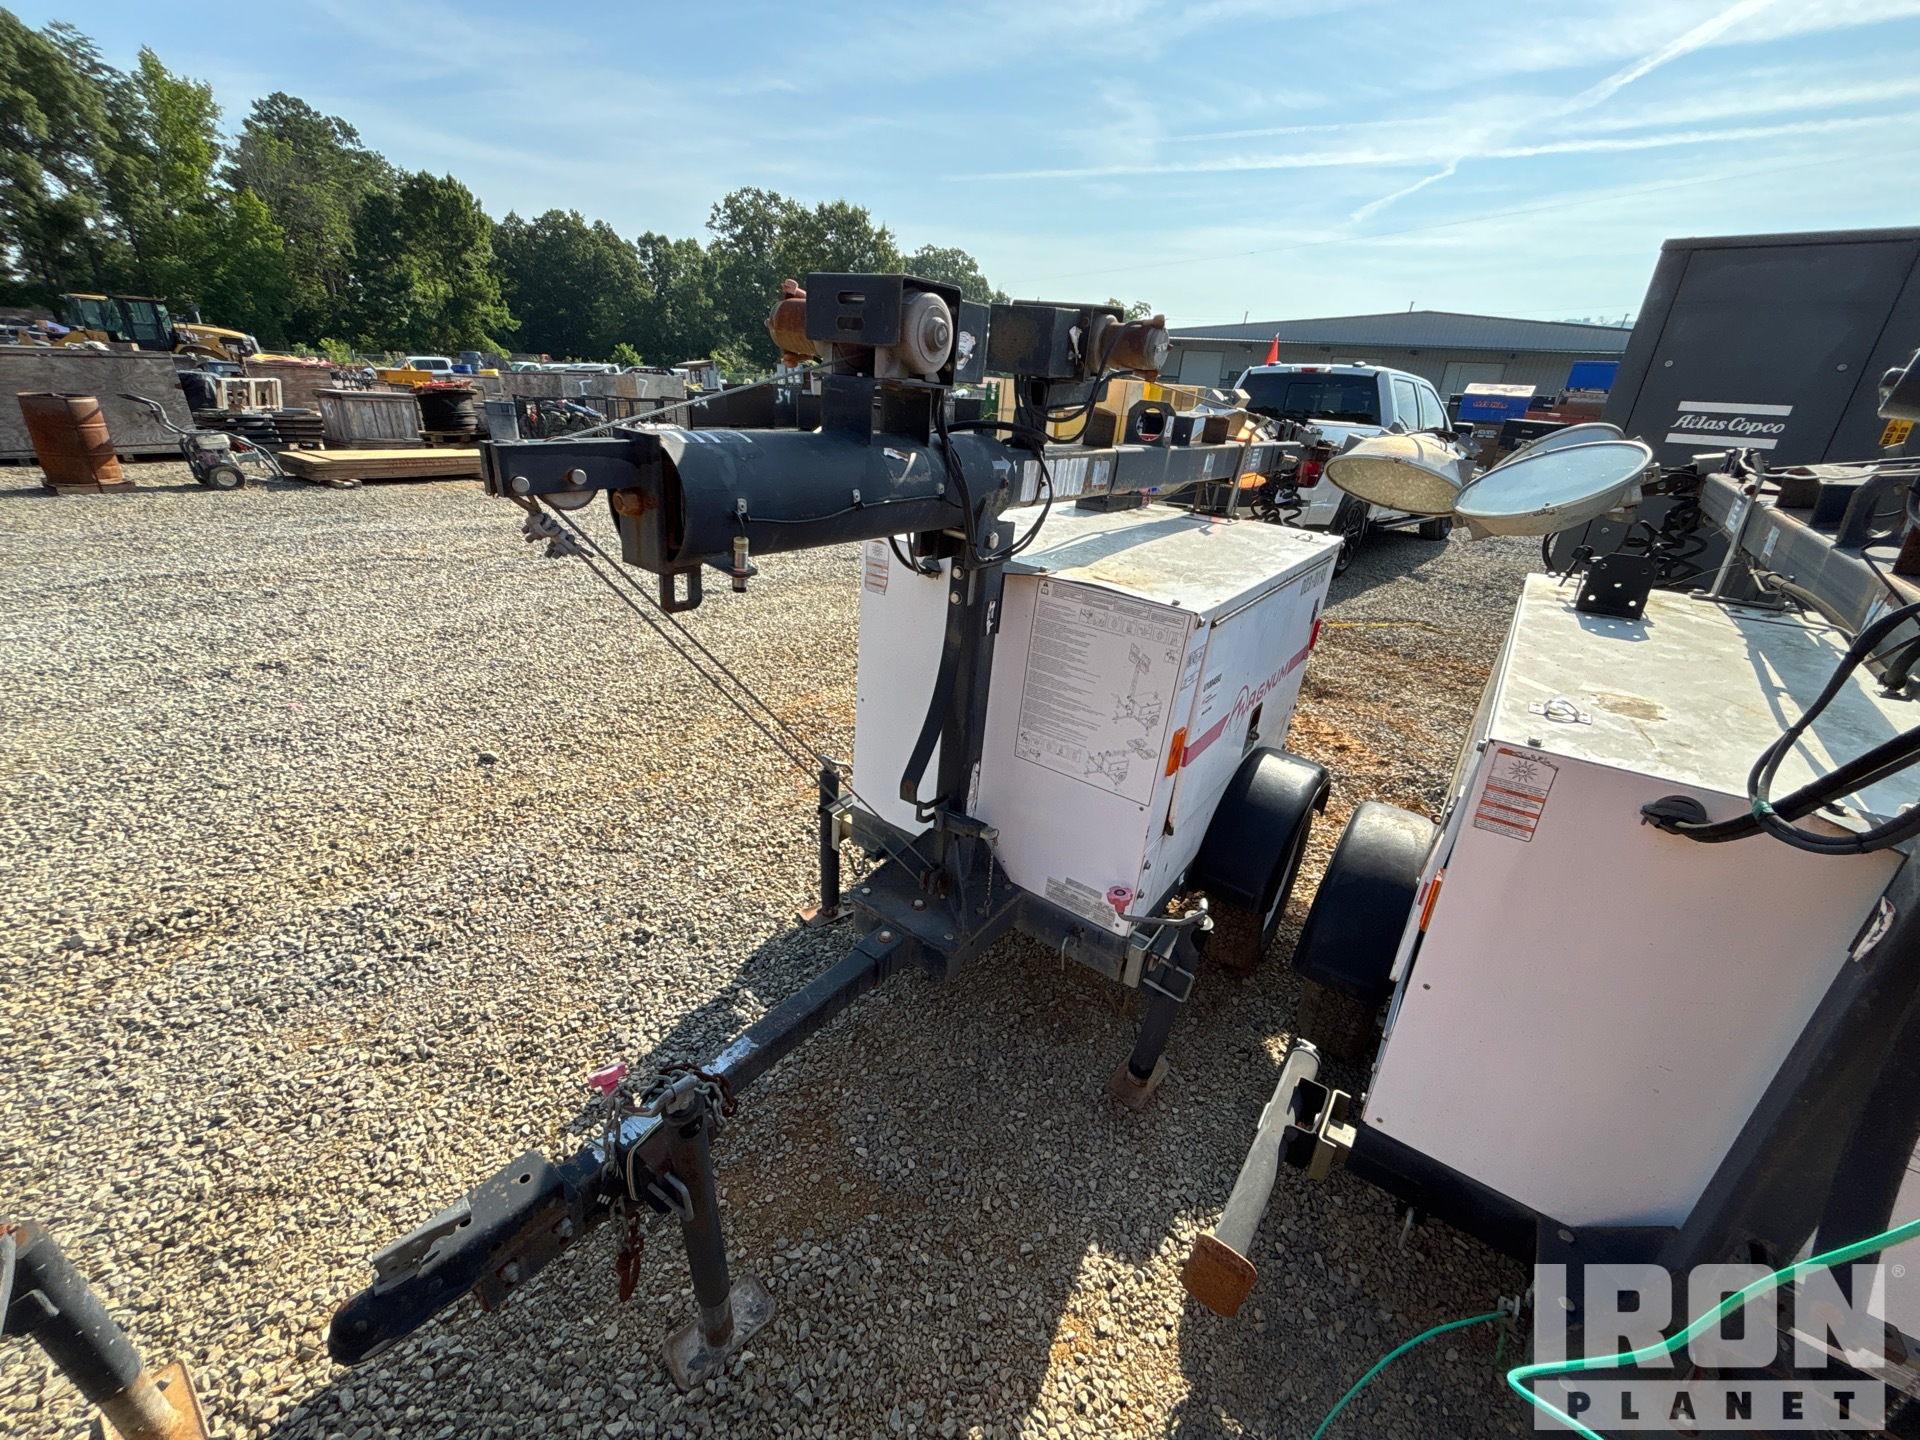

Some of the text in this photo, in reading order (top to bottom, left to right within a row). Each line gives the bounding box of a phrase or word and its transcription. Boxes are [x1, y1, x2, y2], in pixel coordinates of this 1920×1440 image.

[1670, 414, 1786, 435] Atlas Copco
[1231, 664, 1290, 718] MAGNUM
